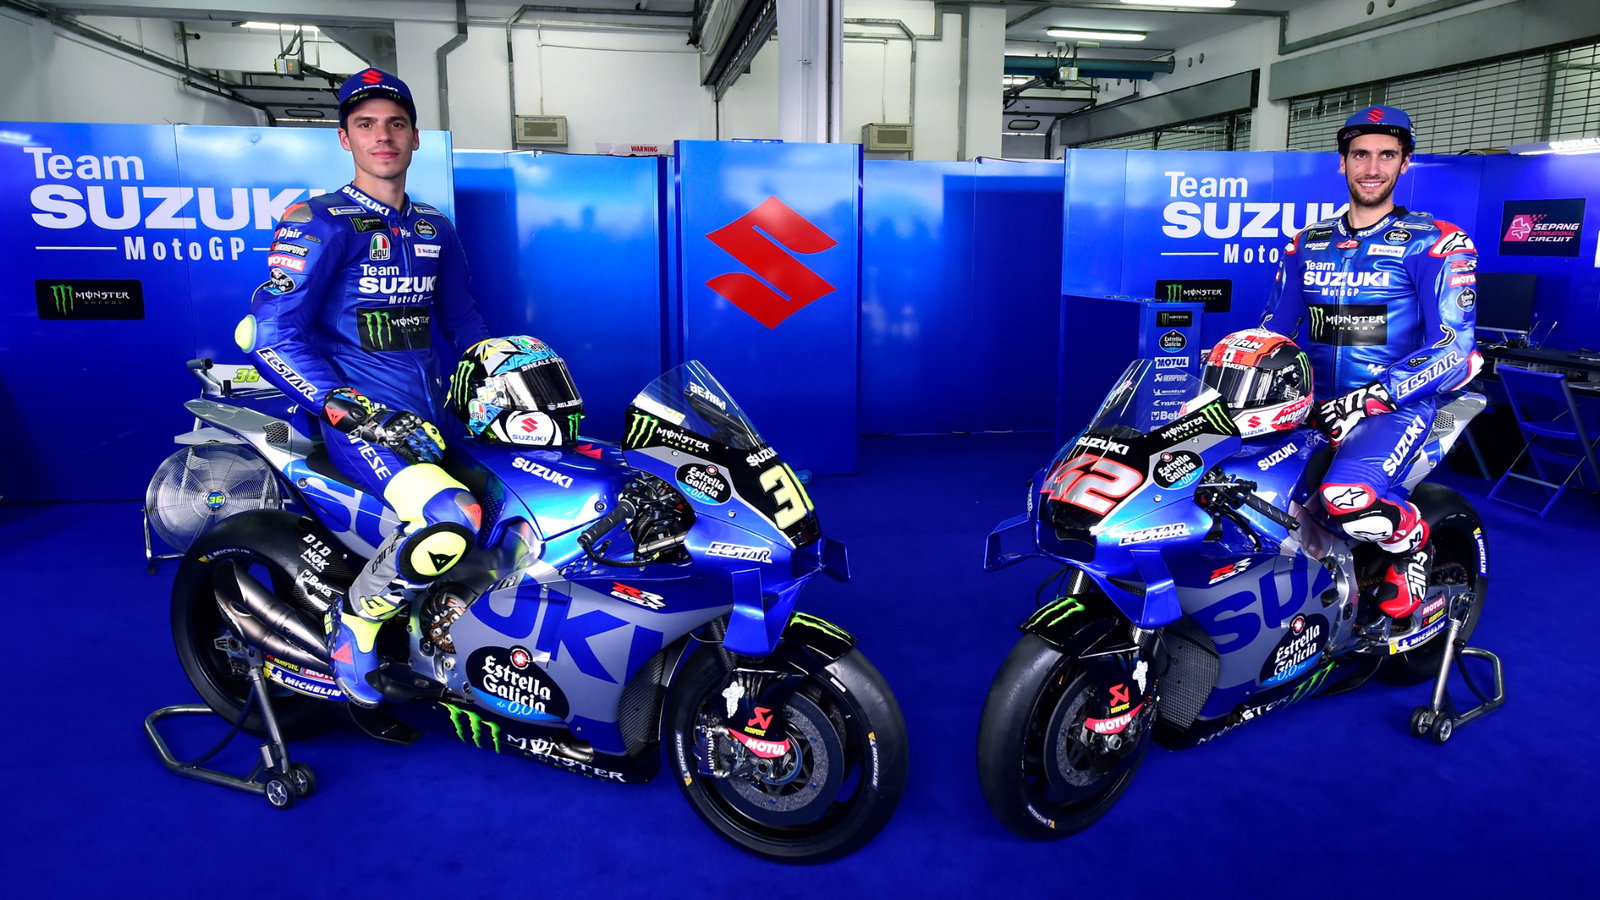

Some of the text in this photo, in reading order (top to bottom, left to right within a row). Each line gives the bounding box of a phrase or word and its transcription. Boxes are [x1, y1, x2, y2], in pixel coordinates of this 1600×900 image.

[24, 147, 145, 180] Team
[1164, 171, 1248, 197] Team
[342, 185, 390, 217] SUZUKI
[1533, 223, 1580, 231] SEPANG
[124, 236, 245, 261] MotoGP
[1223, 243, 1279, 263] Moto
[360, 264, 400, 277] Team
[1305, 260, 1336, 271] Team
[358, 276, 437, 294] SUZUK
[1303, 272, 1390, 287] SUZUKI
[1450, 274, 1477, 286] MOTU
[75, 290, 130, 300] MONSTER
[388, 294, 424, 305] MotoGP
[1321, 287, 1360, 297] MotoGP
[1325, 314, 1386, 325] MONSTER
[1157, 358, 1187, 367] MOTUL
[233, 368, 261, 383] 36
[257, 347, 318, 402] ECSTAR
[1396, 350, 1465, 400] ECSTAR
[1160, 410, 1181, 420] Bet
[512, 434, 547, 442] SUZUKI
[656, 426, 710, 452] MONSTER
[1161, 416, 1207, 440] MONSTER
[1075, 435, 1130, 456] SUZUKI
[1257, 442, 1299, 472] SUZUKI
[1382, 414, 1427, 477] SUZUKI
[512, 457, 573, 488] SUZUKI
[1157, 454, 1191, 477] Estrella
[1165, 462, 1197, 483] Galicia
[685, 474, 719, 498] Galicia
[687, 466, 725, 491] Estrella
[208, 496, 224, 505] 36
[1118, 523, 1192, 547] ECSTAR
[303, 547, 330, 570] NGK
[705, 541, 773, 564] ECSTAR
[1477, 538, 1487, 575] MICHELIN
[308, 574, 332, 598] Beta
[1422, 597, 1443, 616] MOTUL
[1274, 624, 1320, 664] Estrella
[1410, 620, 1446, 646] MICHELIN
[1273, 641, 1317, 676] Galicia
[284, 676, 342, 697] MICHELIN
[482, 654, 551, 701] Estrella
[483, 673, 546, 714] Galicia
[1094, 714, 1133, 733] MOTUL
[675, 733, 687, 774] MICHELIN
[745, 738, 786, 756] MOTUL
[870, 745, 879, 787] MICHELIN
